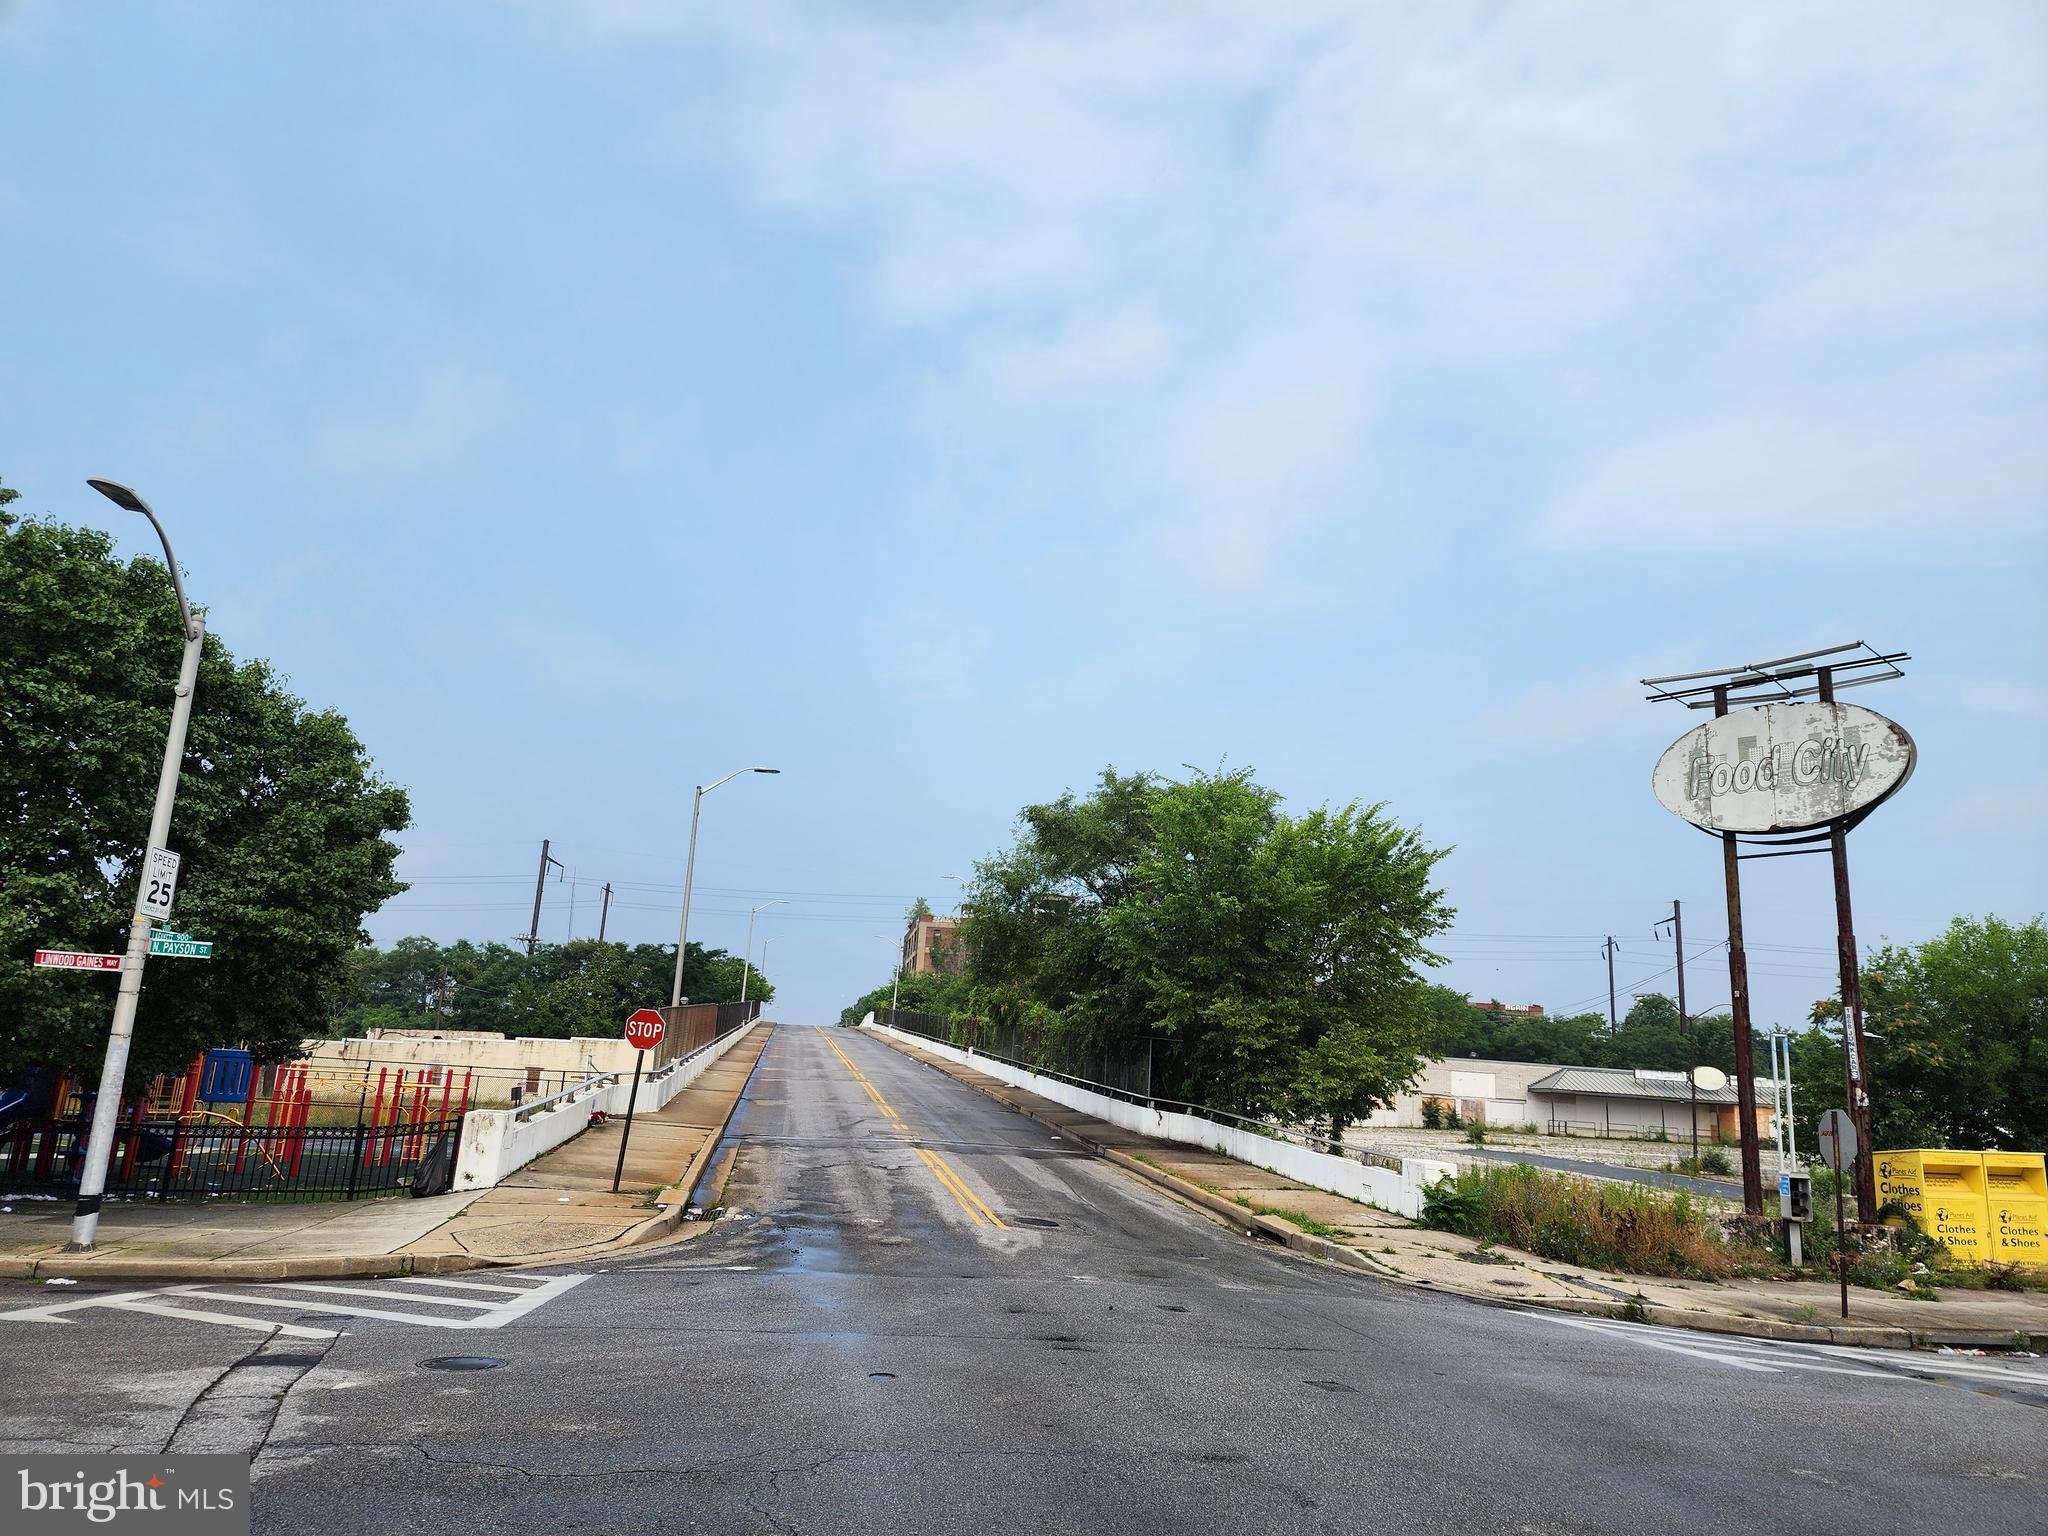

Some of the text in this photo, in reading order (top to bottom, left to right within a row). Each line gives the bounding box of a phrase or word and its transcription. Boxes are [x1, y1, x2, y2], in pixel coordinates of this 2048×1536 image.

[1688, 737, 1871, 801] Food City
[153, 853, 177, 869] SPEED
[152, 867, 173, 881] LIMIT
[147, 880, 171, 907] 25
[162, 942, 197, 955] PAYSON
[41, 953, 118, 968] LINWOOD GAINES WAY
[628, 1021, 662, 1038] STOP
[1880, 1182, 1920, 1196] Clothes
[1937, 1224, 1976, 1234] Clothes
[2000, 1226, 2039, 1236] Clothes
[1938, 1236, 1978, 1246] & Shoes
[2001, 1238, 2041, 1248] & Shoes
